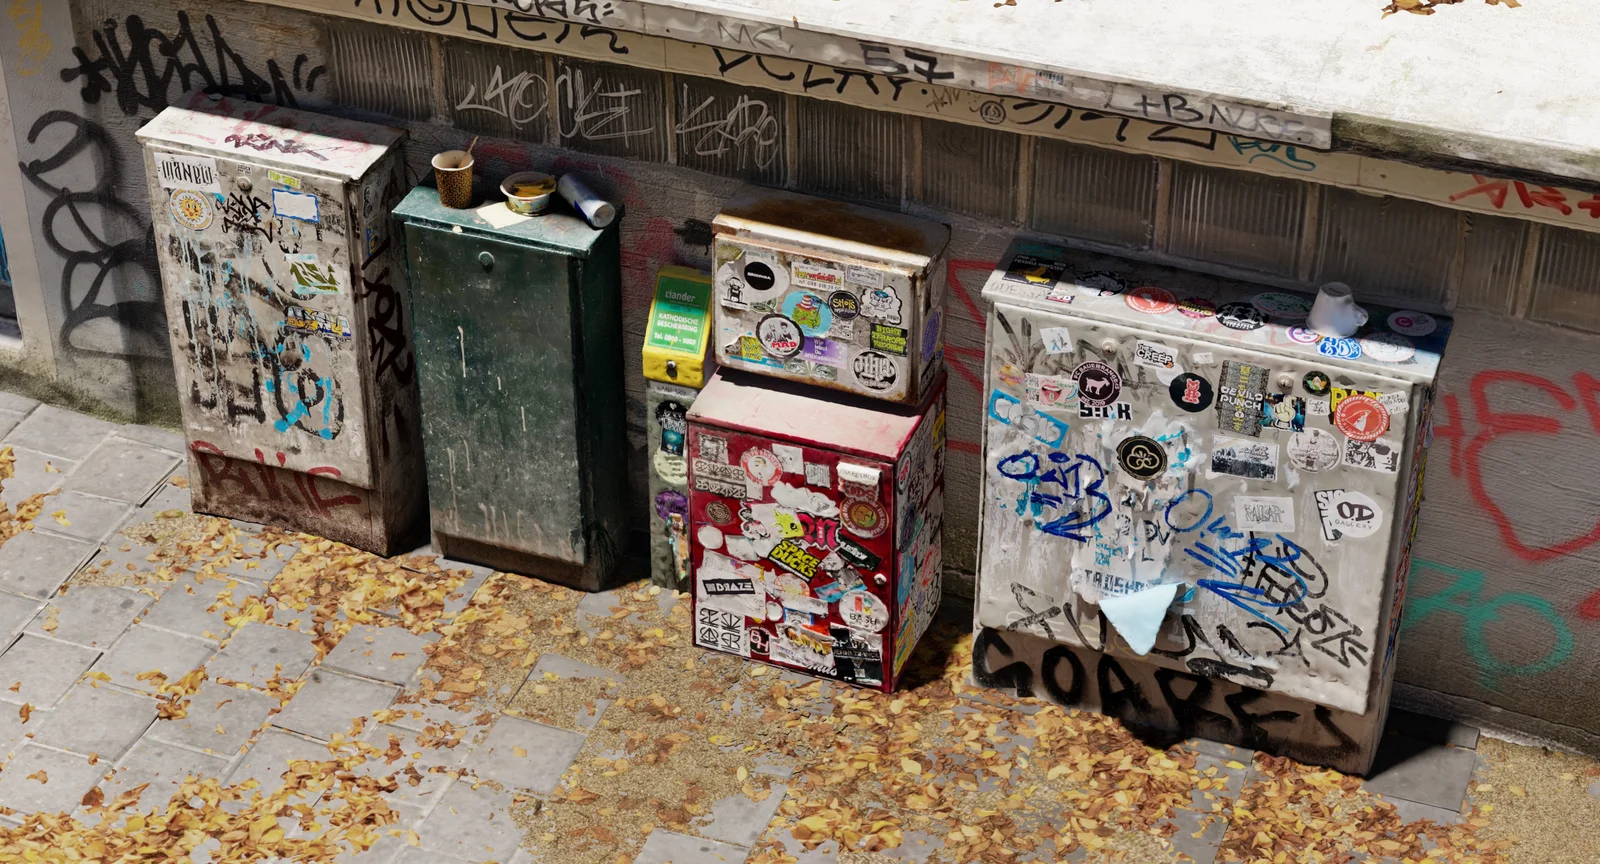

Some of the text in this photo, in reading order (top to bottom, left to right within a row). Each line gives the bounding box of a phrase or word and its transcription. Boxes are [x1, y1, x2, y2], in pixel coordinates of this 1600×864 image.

[659, 313, 698, 325] KATHODISCHE
[657, 320, 697, 333] BESCHERMING
[1220, 395, 1262, 411] PUNCH
[1334, 520, 1373, 530] GALLERY
[780, 540, 821, 567] SPACE
[771, 547, 818, 578] DUCKS
